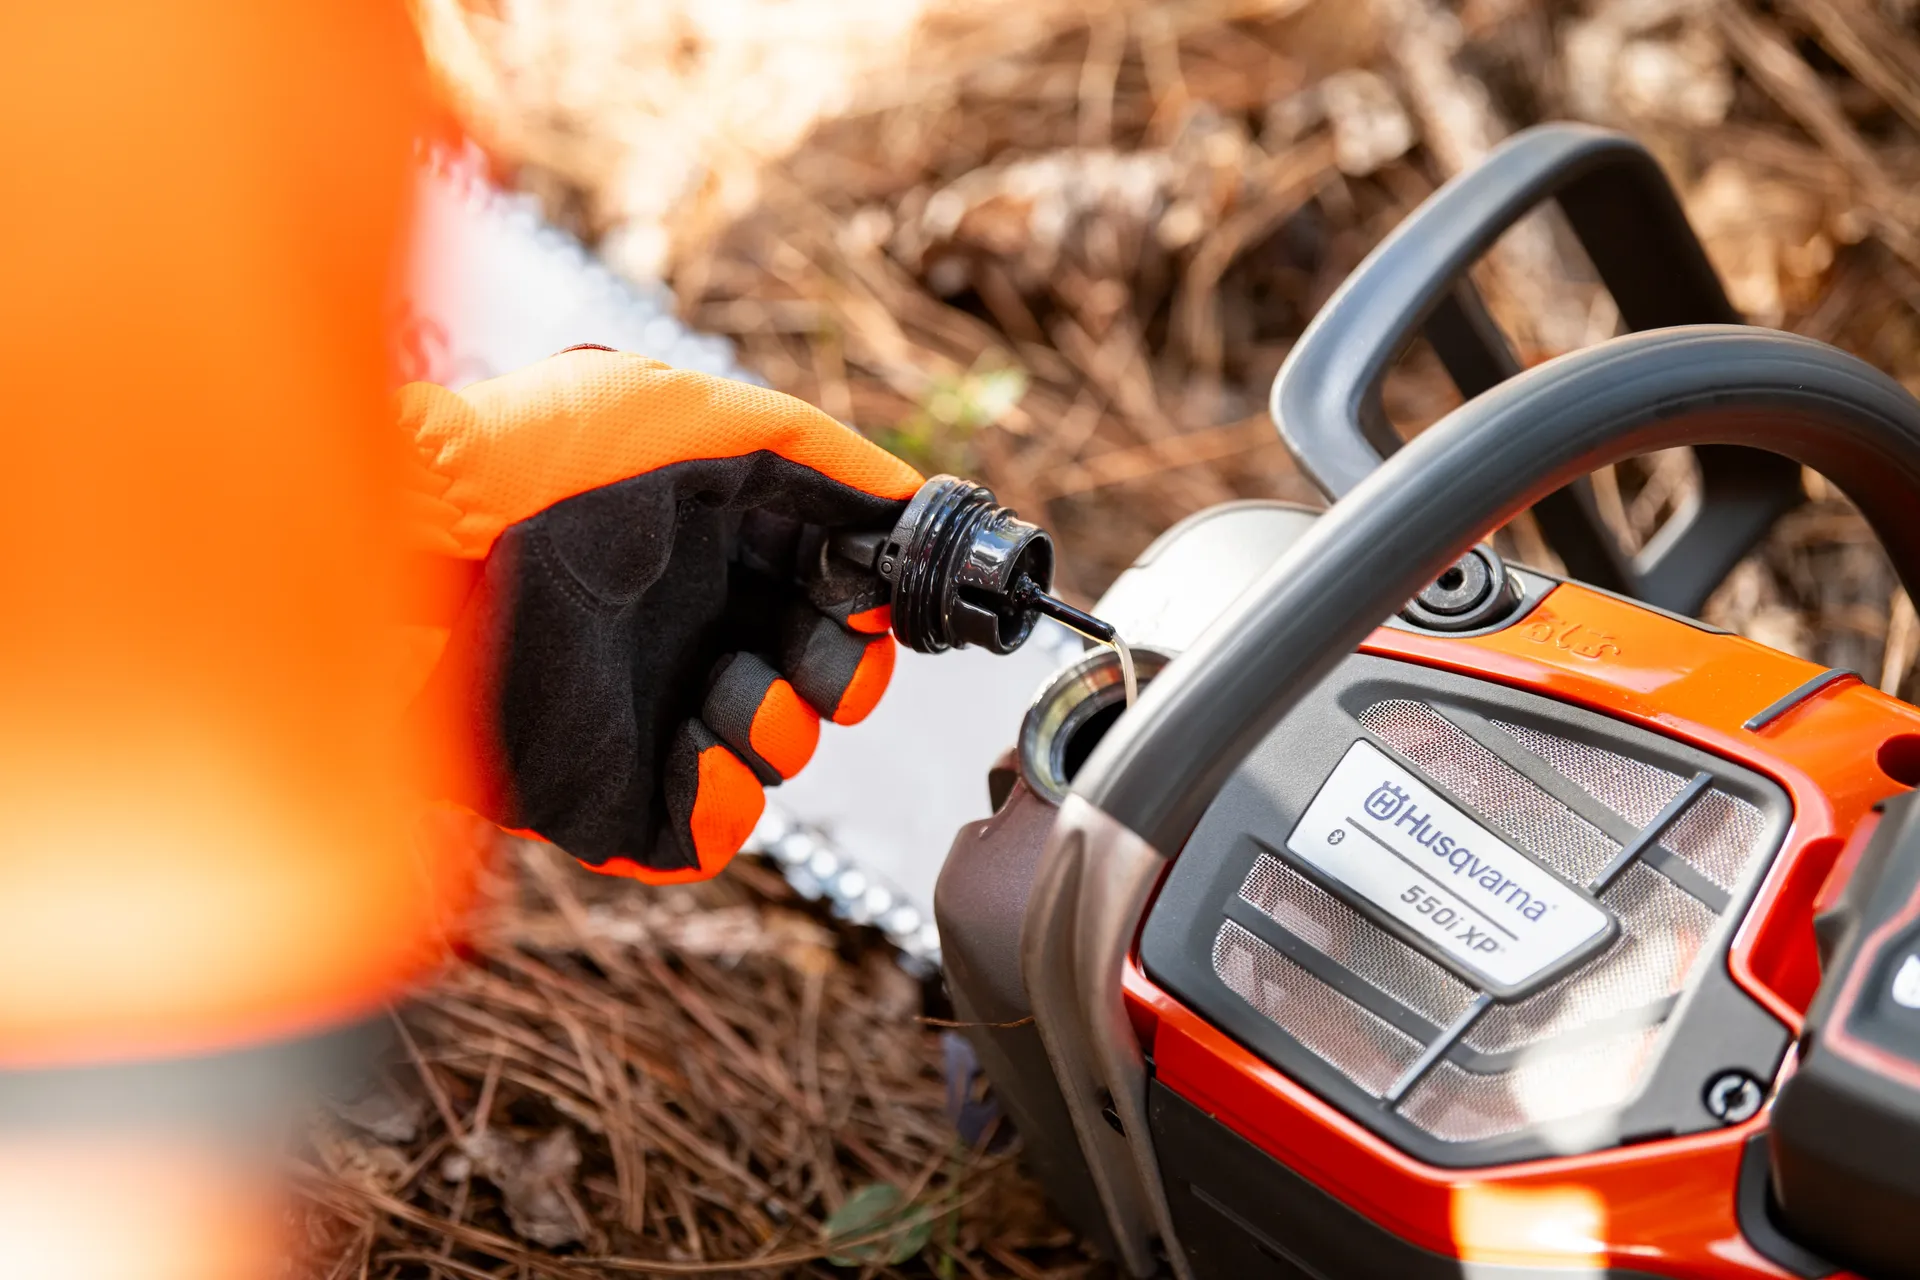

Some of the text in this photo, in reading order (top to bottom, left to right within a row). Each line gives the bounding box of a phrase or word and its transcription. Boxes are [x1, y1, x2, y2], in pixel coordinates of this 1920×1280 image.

[1394, 804, 1547, 922] Husqvarna
[1400, 884, 1500, 953] 550i XP
